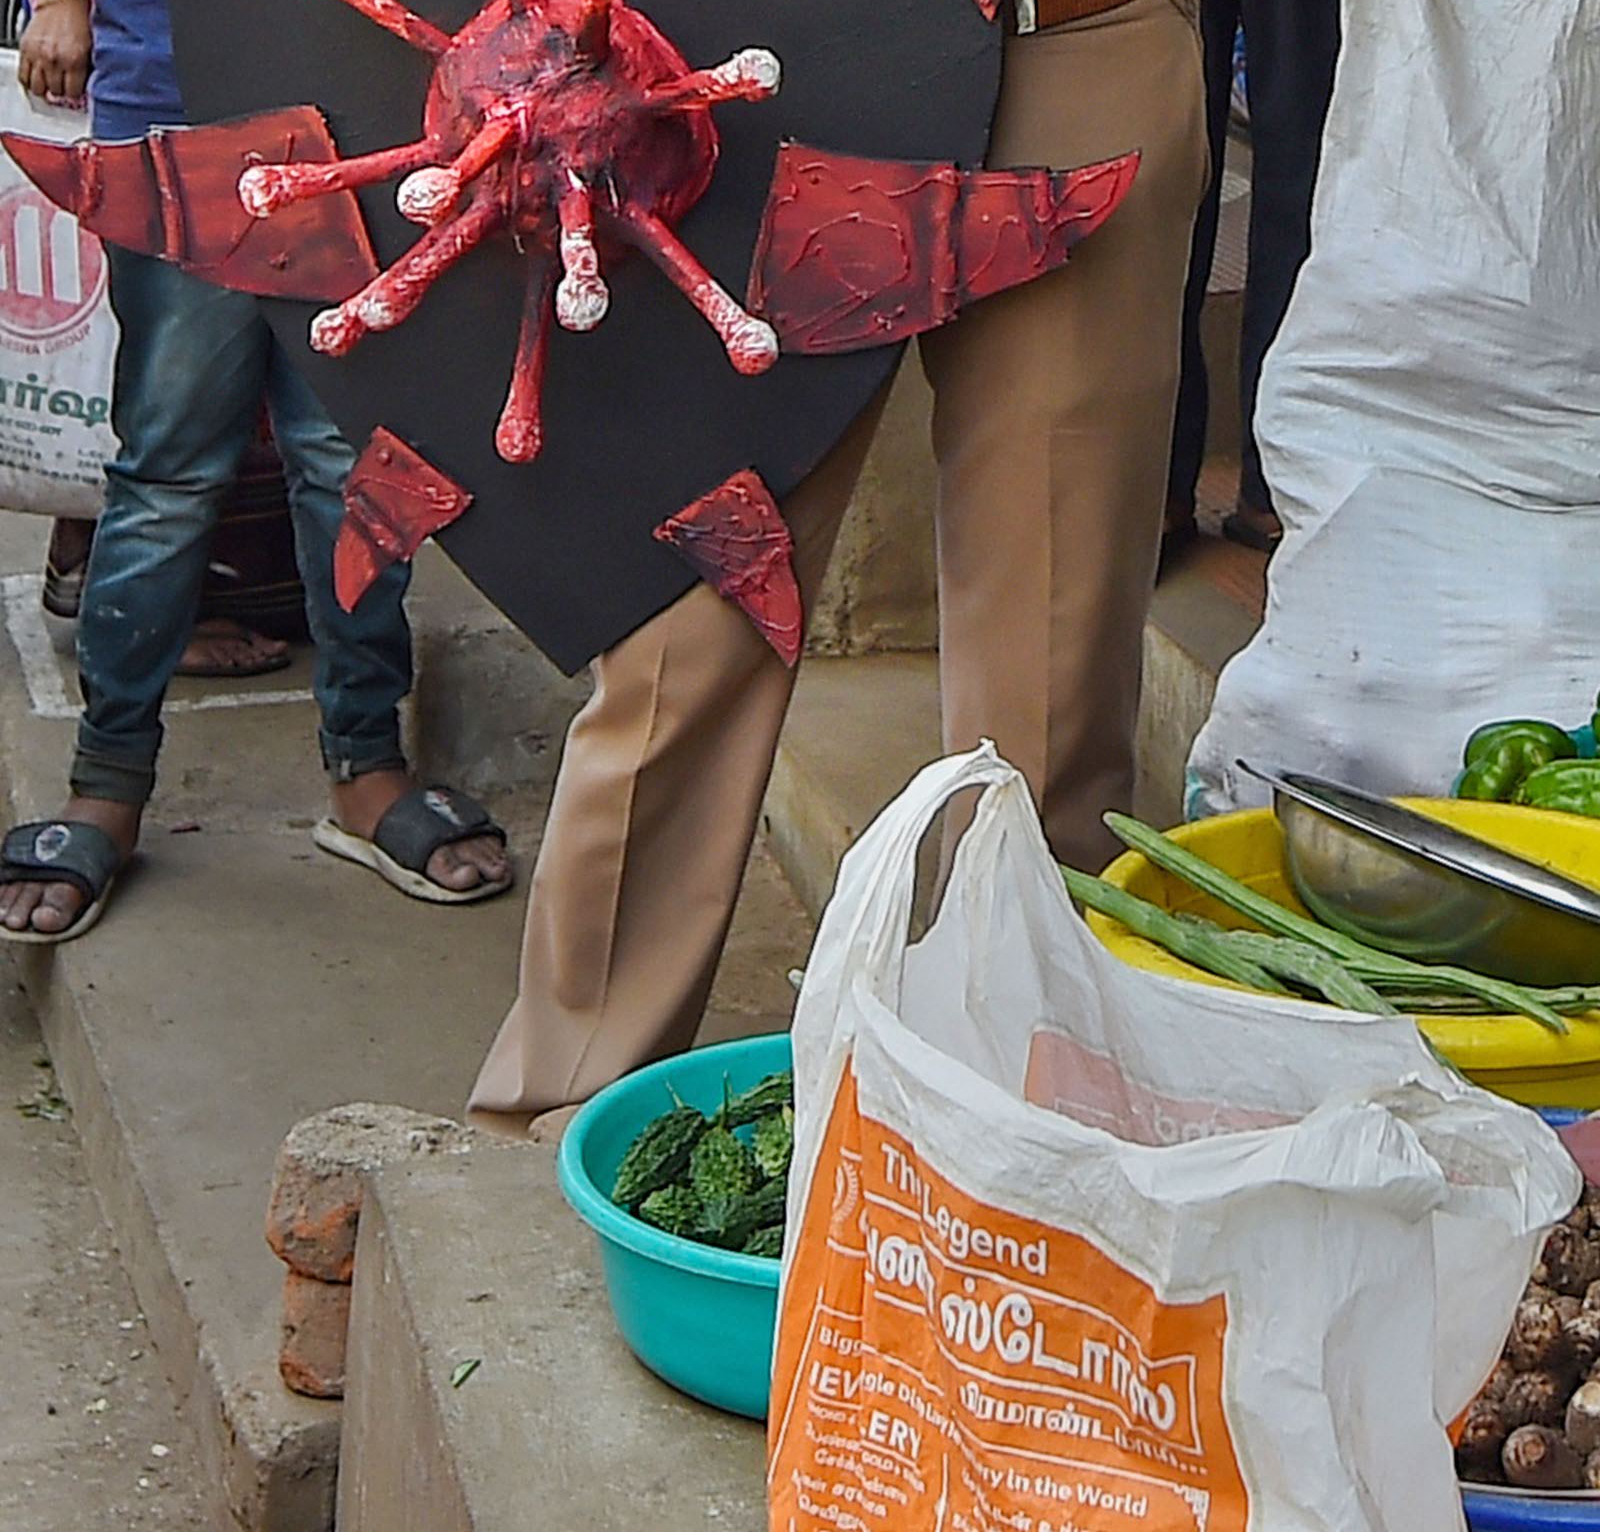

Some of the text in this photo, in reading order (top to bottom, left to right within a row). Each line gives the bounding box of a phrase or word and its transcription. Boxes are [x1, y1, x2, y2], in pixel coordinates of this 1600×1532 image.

[881, 1142, 922, 1202] Th
[922, 1182, 1048, 1276] Legend
[1035, 1476, 1073, 1501] the
[1077, 1482, 1148, 1518] World
